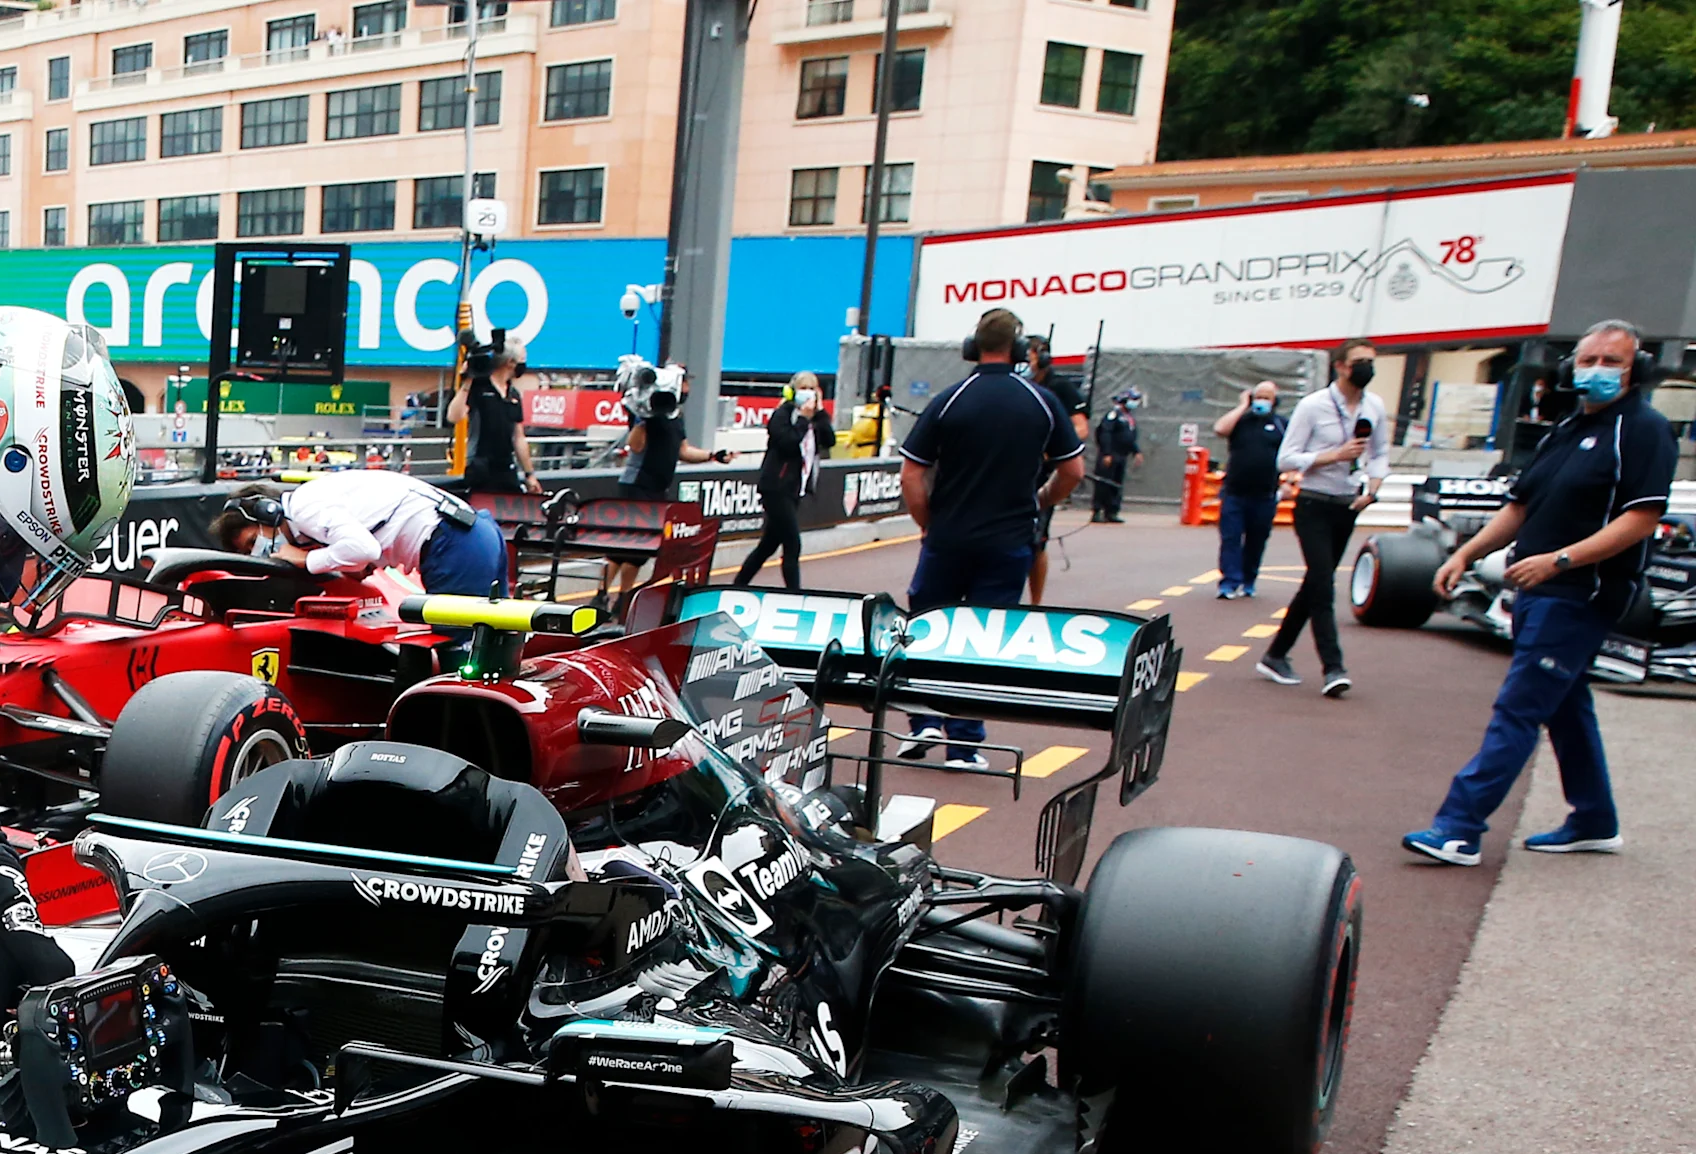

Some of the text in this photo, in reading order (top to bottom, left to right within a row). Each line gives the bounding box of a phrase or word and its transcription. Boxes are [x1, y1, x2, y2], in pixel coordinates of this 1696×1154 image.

[478, 212, 497, 227] 29
[1213, 281, 1344, 305] SINCE 1929
[202, 400, 246, 413] LEX
[314, 402, 356, 415] ROLEX
[531, 394, 567, 414] CASINO
[594, 400, 629, 422] CA
[38, 433, 64, 537] CROWDSTRIKE
[16, 509, 53, 544] EPSON
[231, 712, 246, 743] P
[370, 752, 407, 764] BOTTAS
[368, 875, 525, 916] CROWDSTRIKE
[626, 914, 665, 955] AMD
